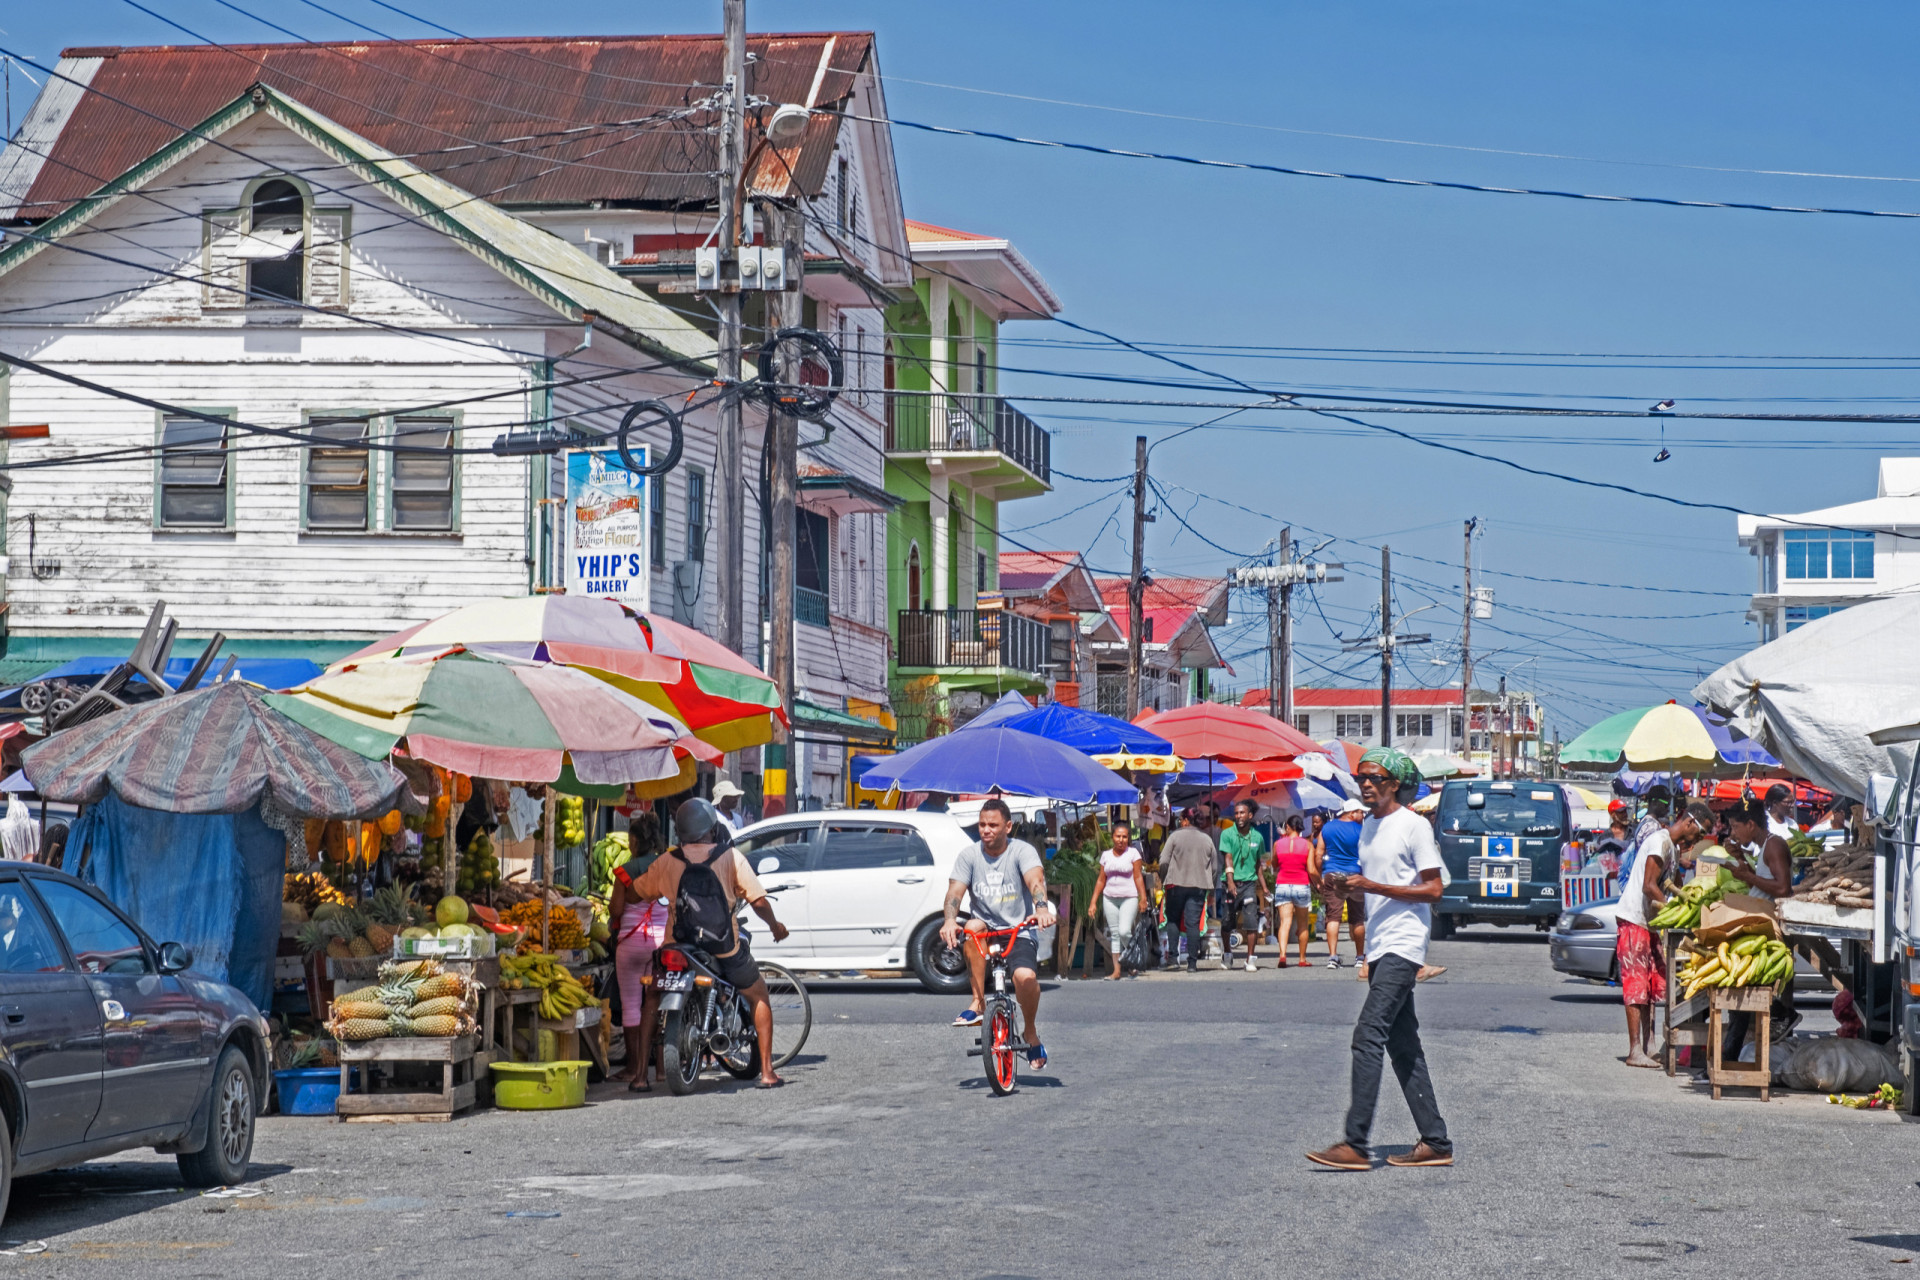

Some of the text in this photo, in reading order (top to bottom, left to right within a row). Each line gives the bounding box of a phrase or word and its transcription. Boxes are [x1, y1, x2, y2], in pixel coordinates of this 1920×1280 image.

[604, 532, 637, 546] Flour
[577, 553, 640, 578] YHIP'S
[587, 579, 629, 593] BAKERY
[665, 970, 681, 980] CJ
[656, 979, 687, 989] 5524
